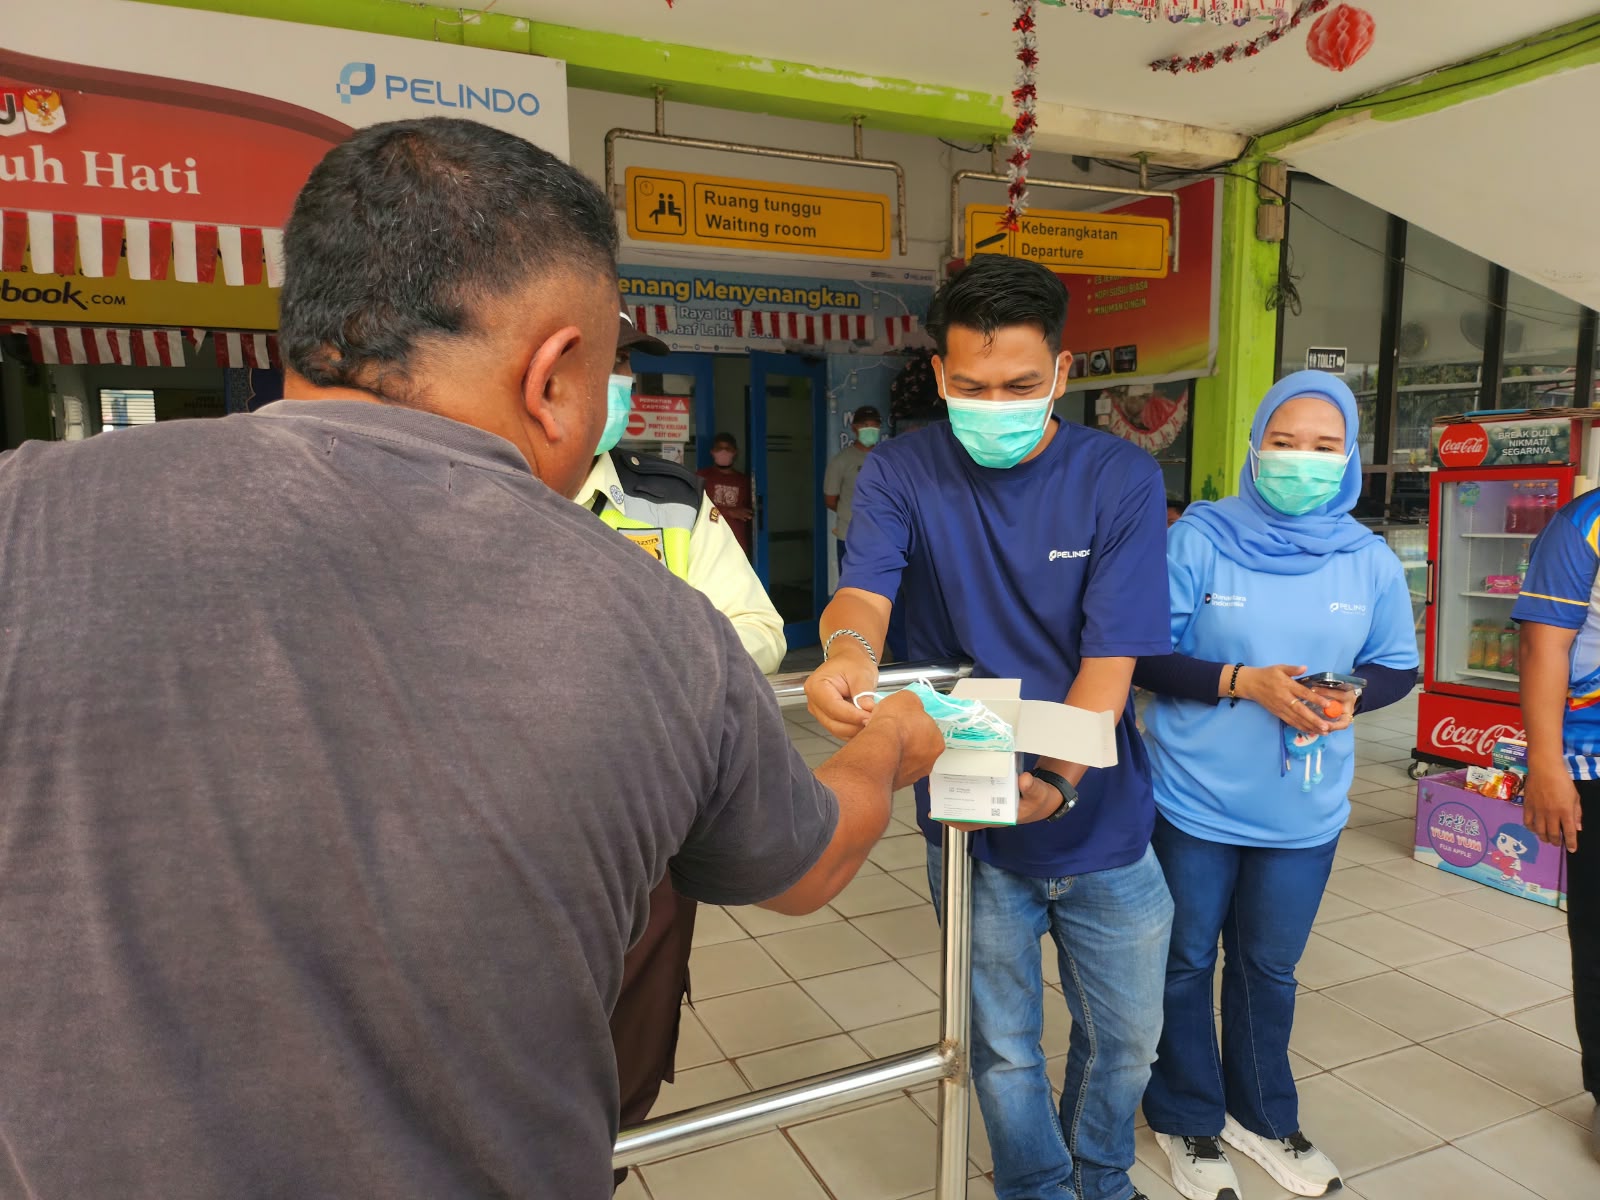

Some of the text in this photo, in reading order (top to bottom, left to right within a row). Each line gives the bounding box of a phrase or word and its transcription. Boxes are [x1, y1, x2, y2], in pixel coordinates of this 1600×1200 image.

[386, 75, 540, 116] PELINDO
[81, 150, 201, 195] Hati
[704, 190, 822, 218] Ruang tunggu
[705, 213, 817, 238] Waiting room
[1021, 221, 1118, 241] Keberangkatan
[1021, 243, 1084, 259] Departure
[0, 278, 126, 311] book.COM
[695, 279, 860, 310] Menyenangkan
[680, 306, 735, 322] Raya Idu
[701, 324, 734, 337] Lahir
[1317, 353, 1337, 368] TOILET
[1498, 429, 1560, 441] BREAK DULU.
[1509, 438, 1548, 448] NIKMATI
[1441, 437, 1485, 455] Coca-Cola
[1502, 446, 1554, 457] SEGARNYA.
[1430, 826, 1482, 852] YUM YUM
[1453, 847, 1472, 859] APPLE
